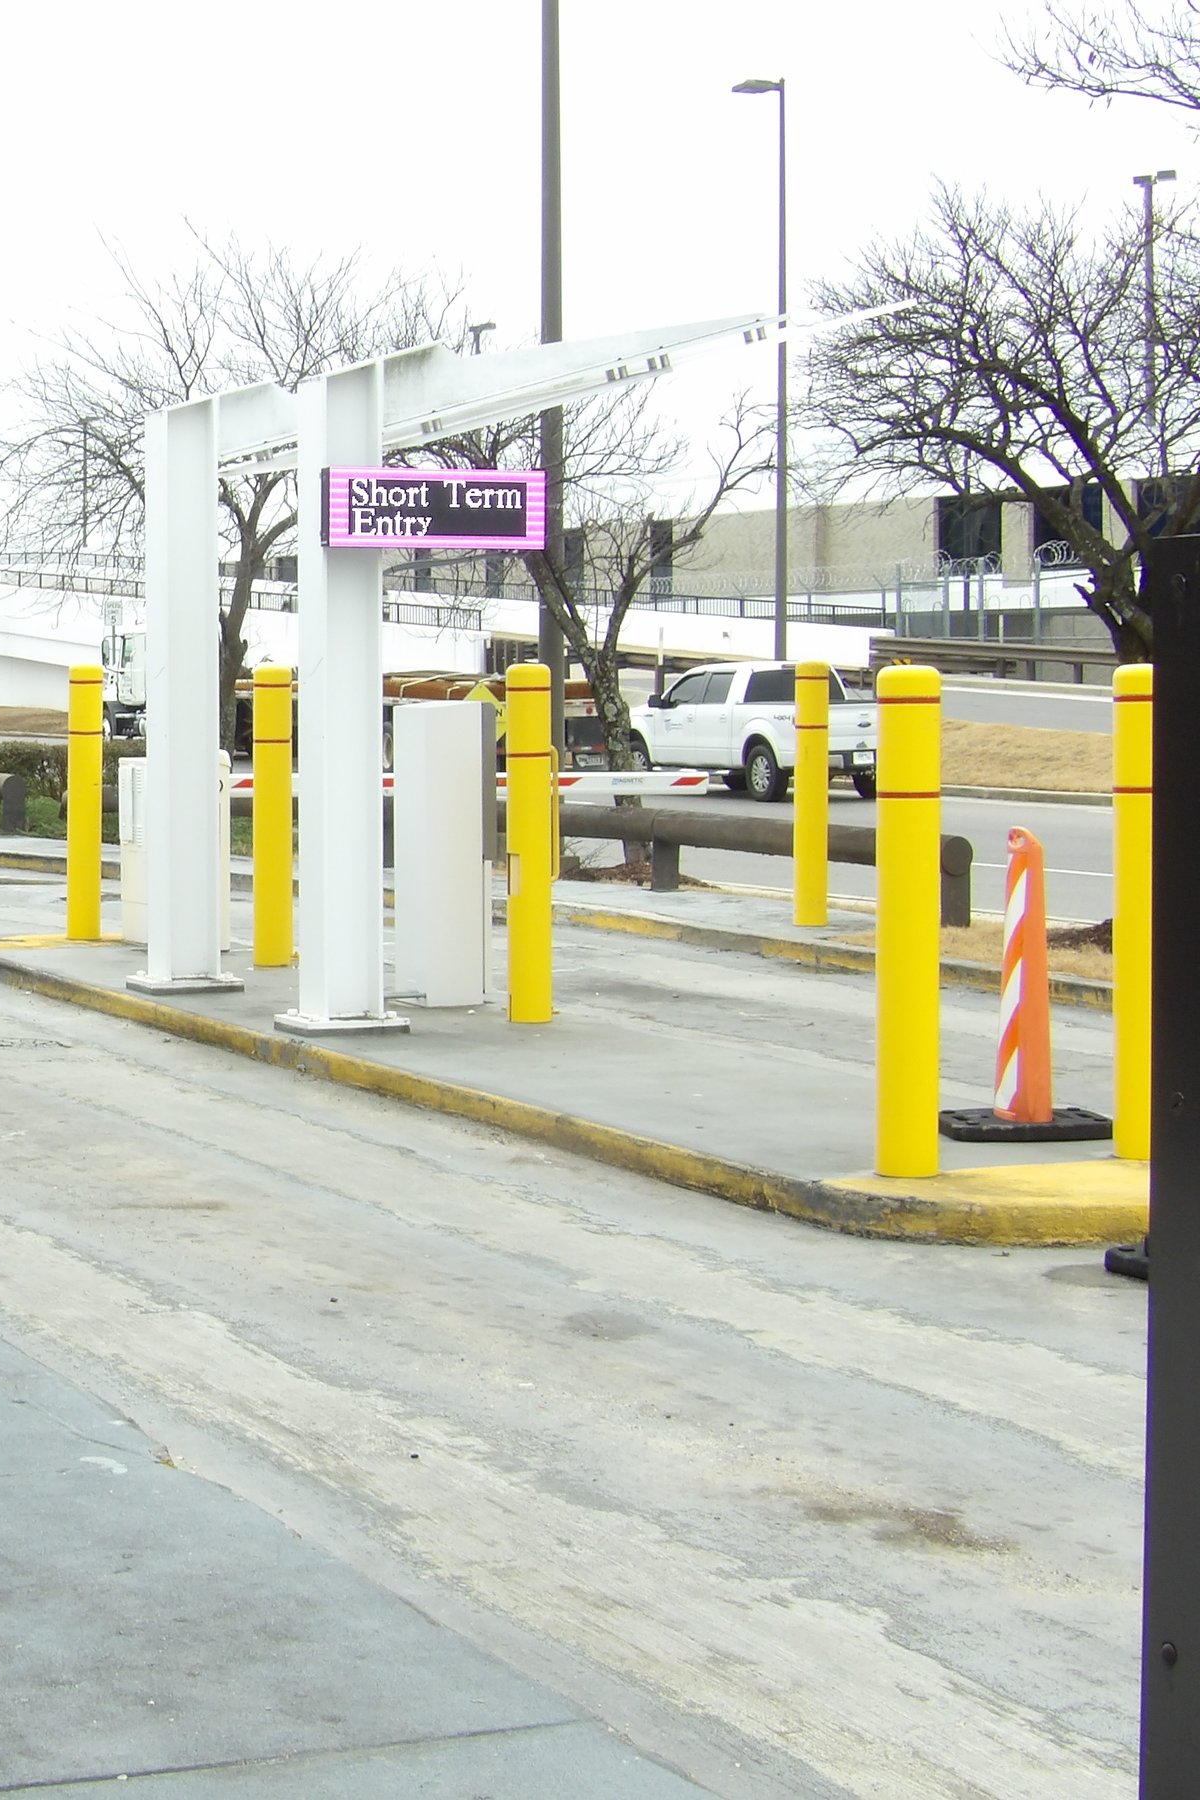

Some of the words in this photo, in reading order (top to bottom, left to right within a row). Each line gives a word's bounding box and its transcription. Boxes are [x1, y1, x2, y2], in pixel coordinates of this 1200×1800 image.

[351, 478, 430, 508] Short
[443, 480, 523, 509] Term
[351, 507, 433, 537] Entry
[111, 615, 117, 624] 5
